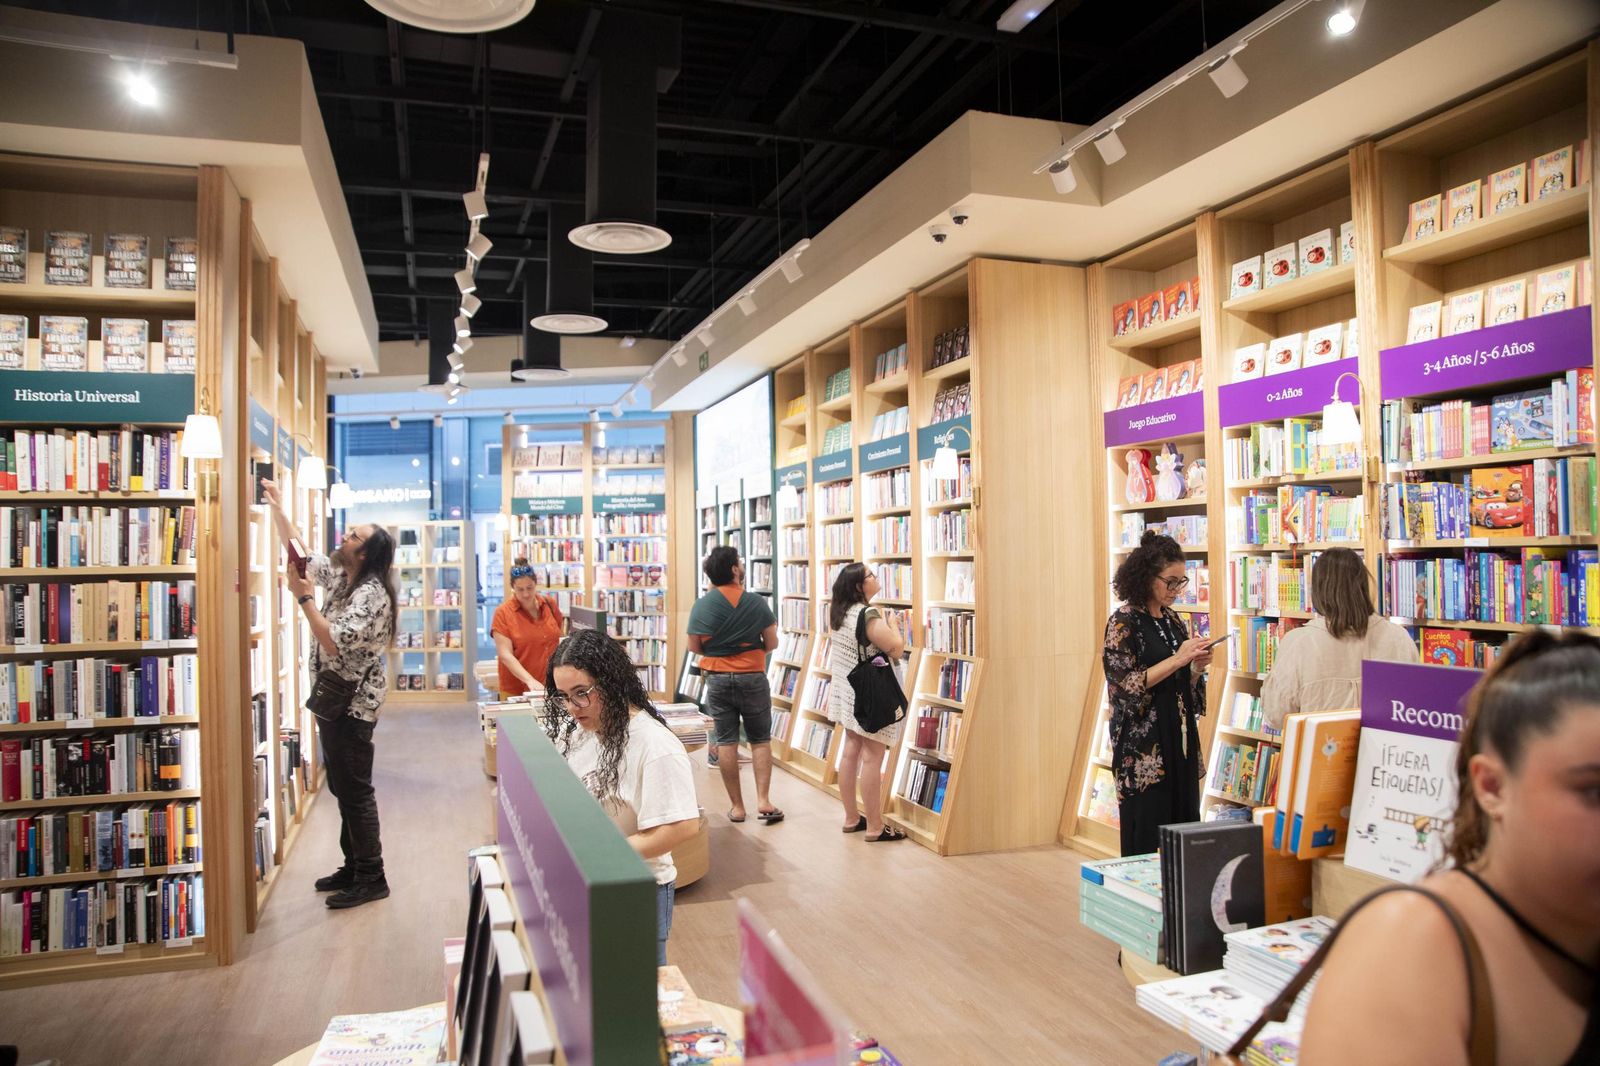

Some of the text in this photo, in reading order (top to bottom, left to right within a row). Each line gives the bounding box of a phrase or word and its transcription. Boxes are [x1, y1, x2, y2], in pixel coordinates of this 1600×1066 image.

[1539, 150, 1569, 166] AMOR
[1495, 168, 1522, 182] AMOR
[1423, 341, 1535, 376] 3-4 Años / 5-6 Años
[14, 388, 141, 404] Historia Universal
[1267, 387, 1303, 402] 0-2 Años
[1128, 412, 1177, 430] Juego Educativo
[1424, 631, 1451, 640] Cuentos
[1391, 699, 1468, 731] Recom
